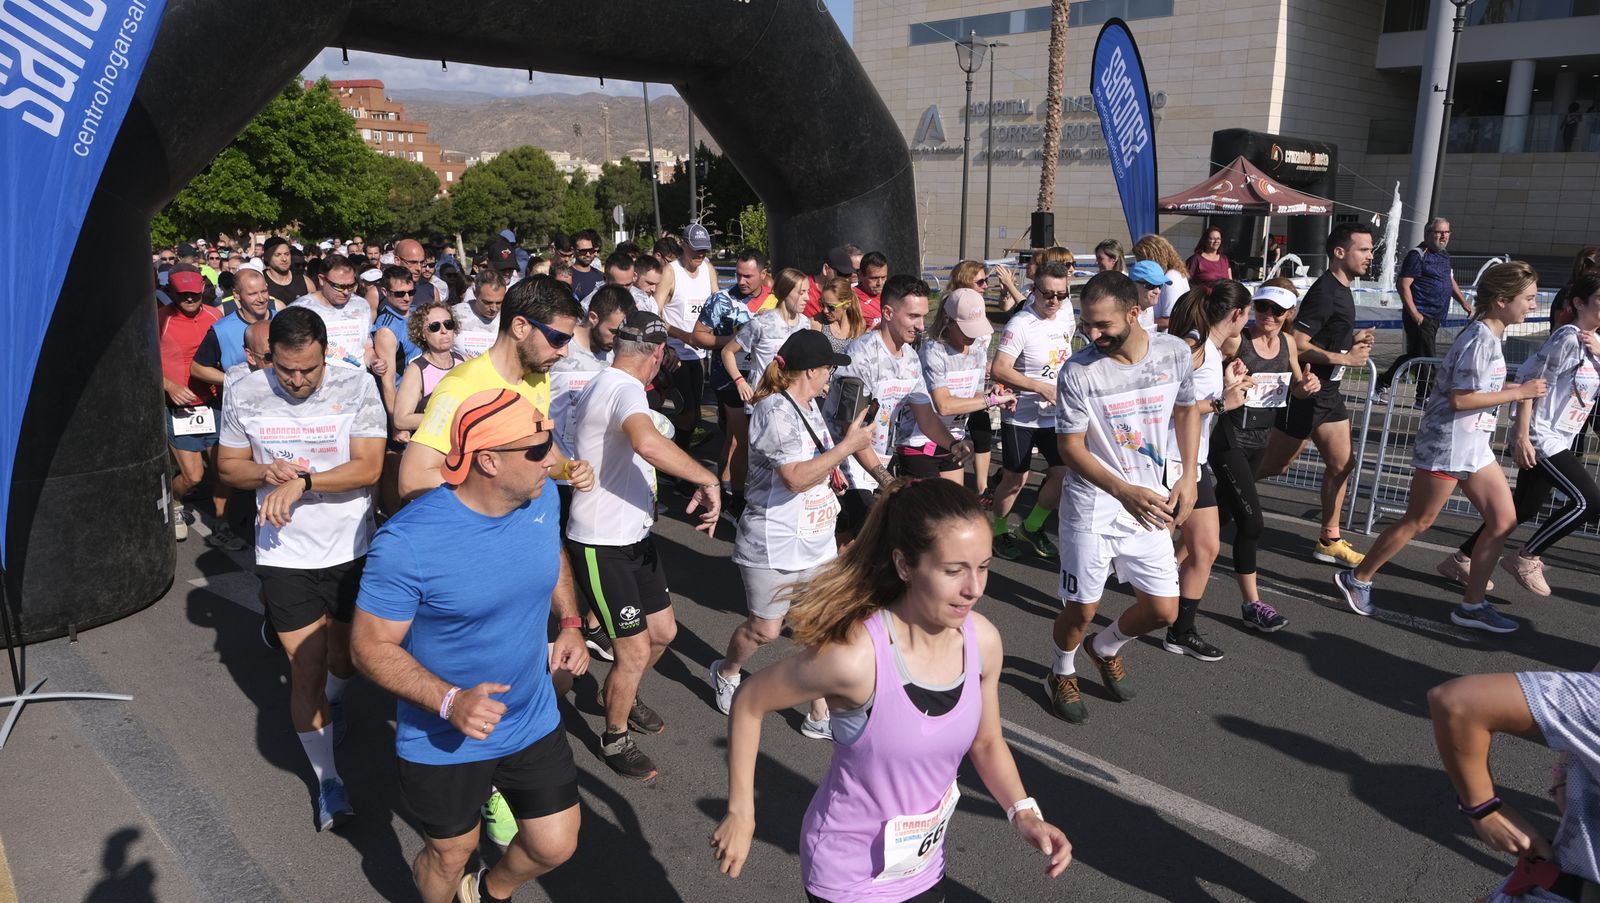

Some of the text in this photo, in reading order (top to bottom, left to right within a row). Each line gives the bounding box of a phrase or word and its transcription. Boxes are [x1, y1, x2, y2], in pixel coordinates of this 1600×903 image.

[189, 415, 204, 425] 70
[1062, 569, 1078, 594] 10
[917, 819, 946, 857] 66
